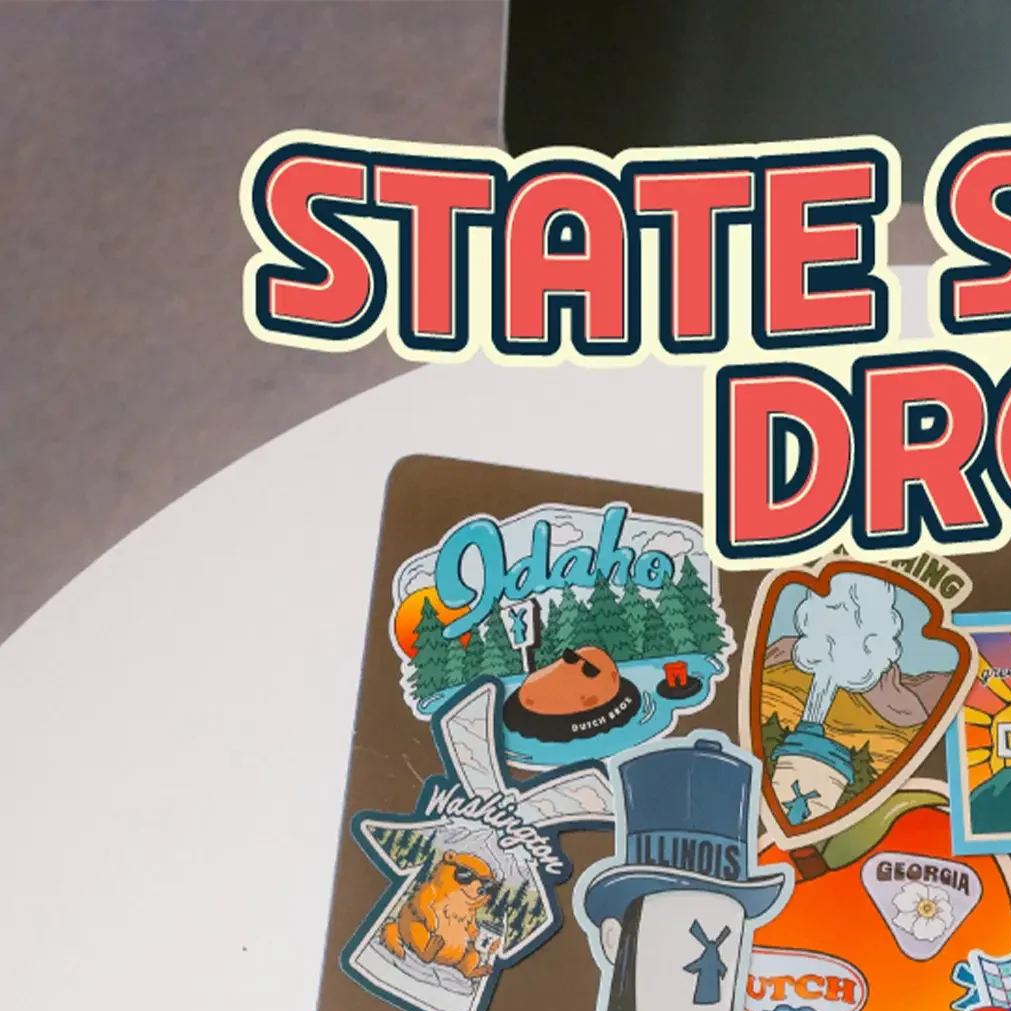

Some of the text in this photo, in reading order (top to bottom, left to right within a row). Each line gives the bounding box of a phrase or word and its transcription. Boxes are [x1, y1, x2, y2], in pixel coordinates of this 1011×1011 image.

[435, 507, 675, 639] Idaho
[571, 696, 634, 733] DUTCH BROS
[425, 784, 564, 875] Washington
[635, 834, 742, 880] ILLINOIS
[876, 861, 970, 896] GEORGIA
[746, 974, 857, 1004] UTCH
